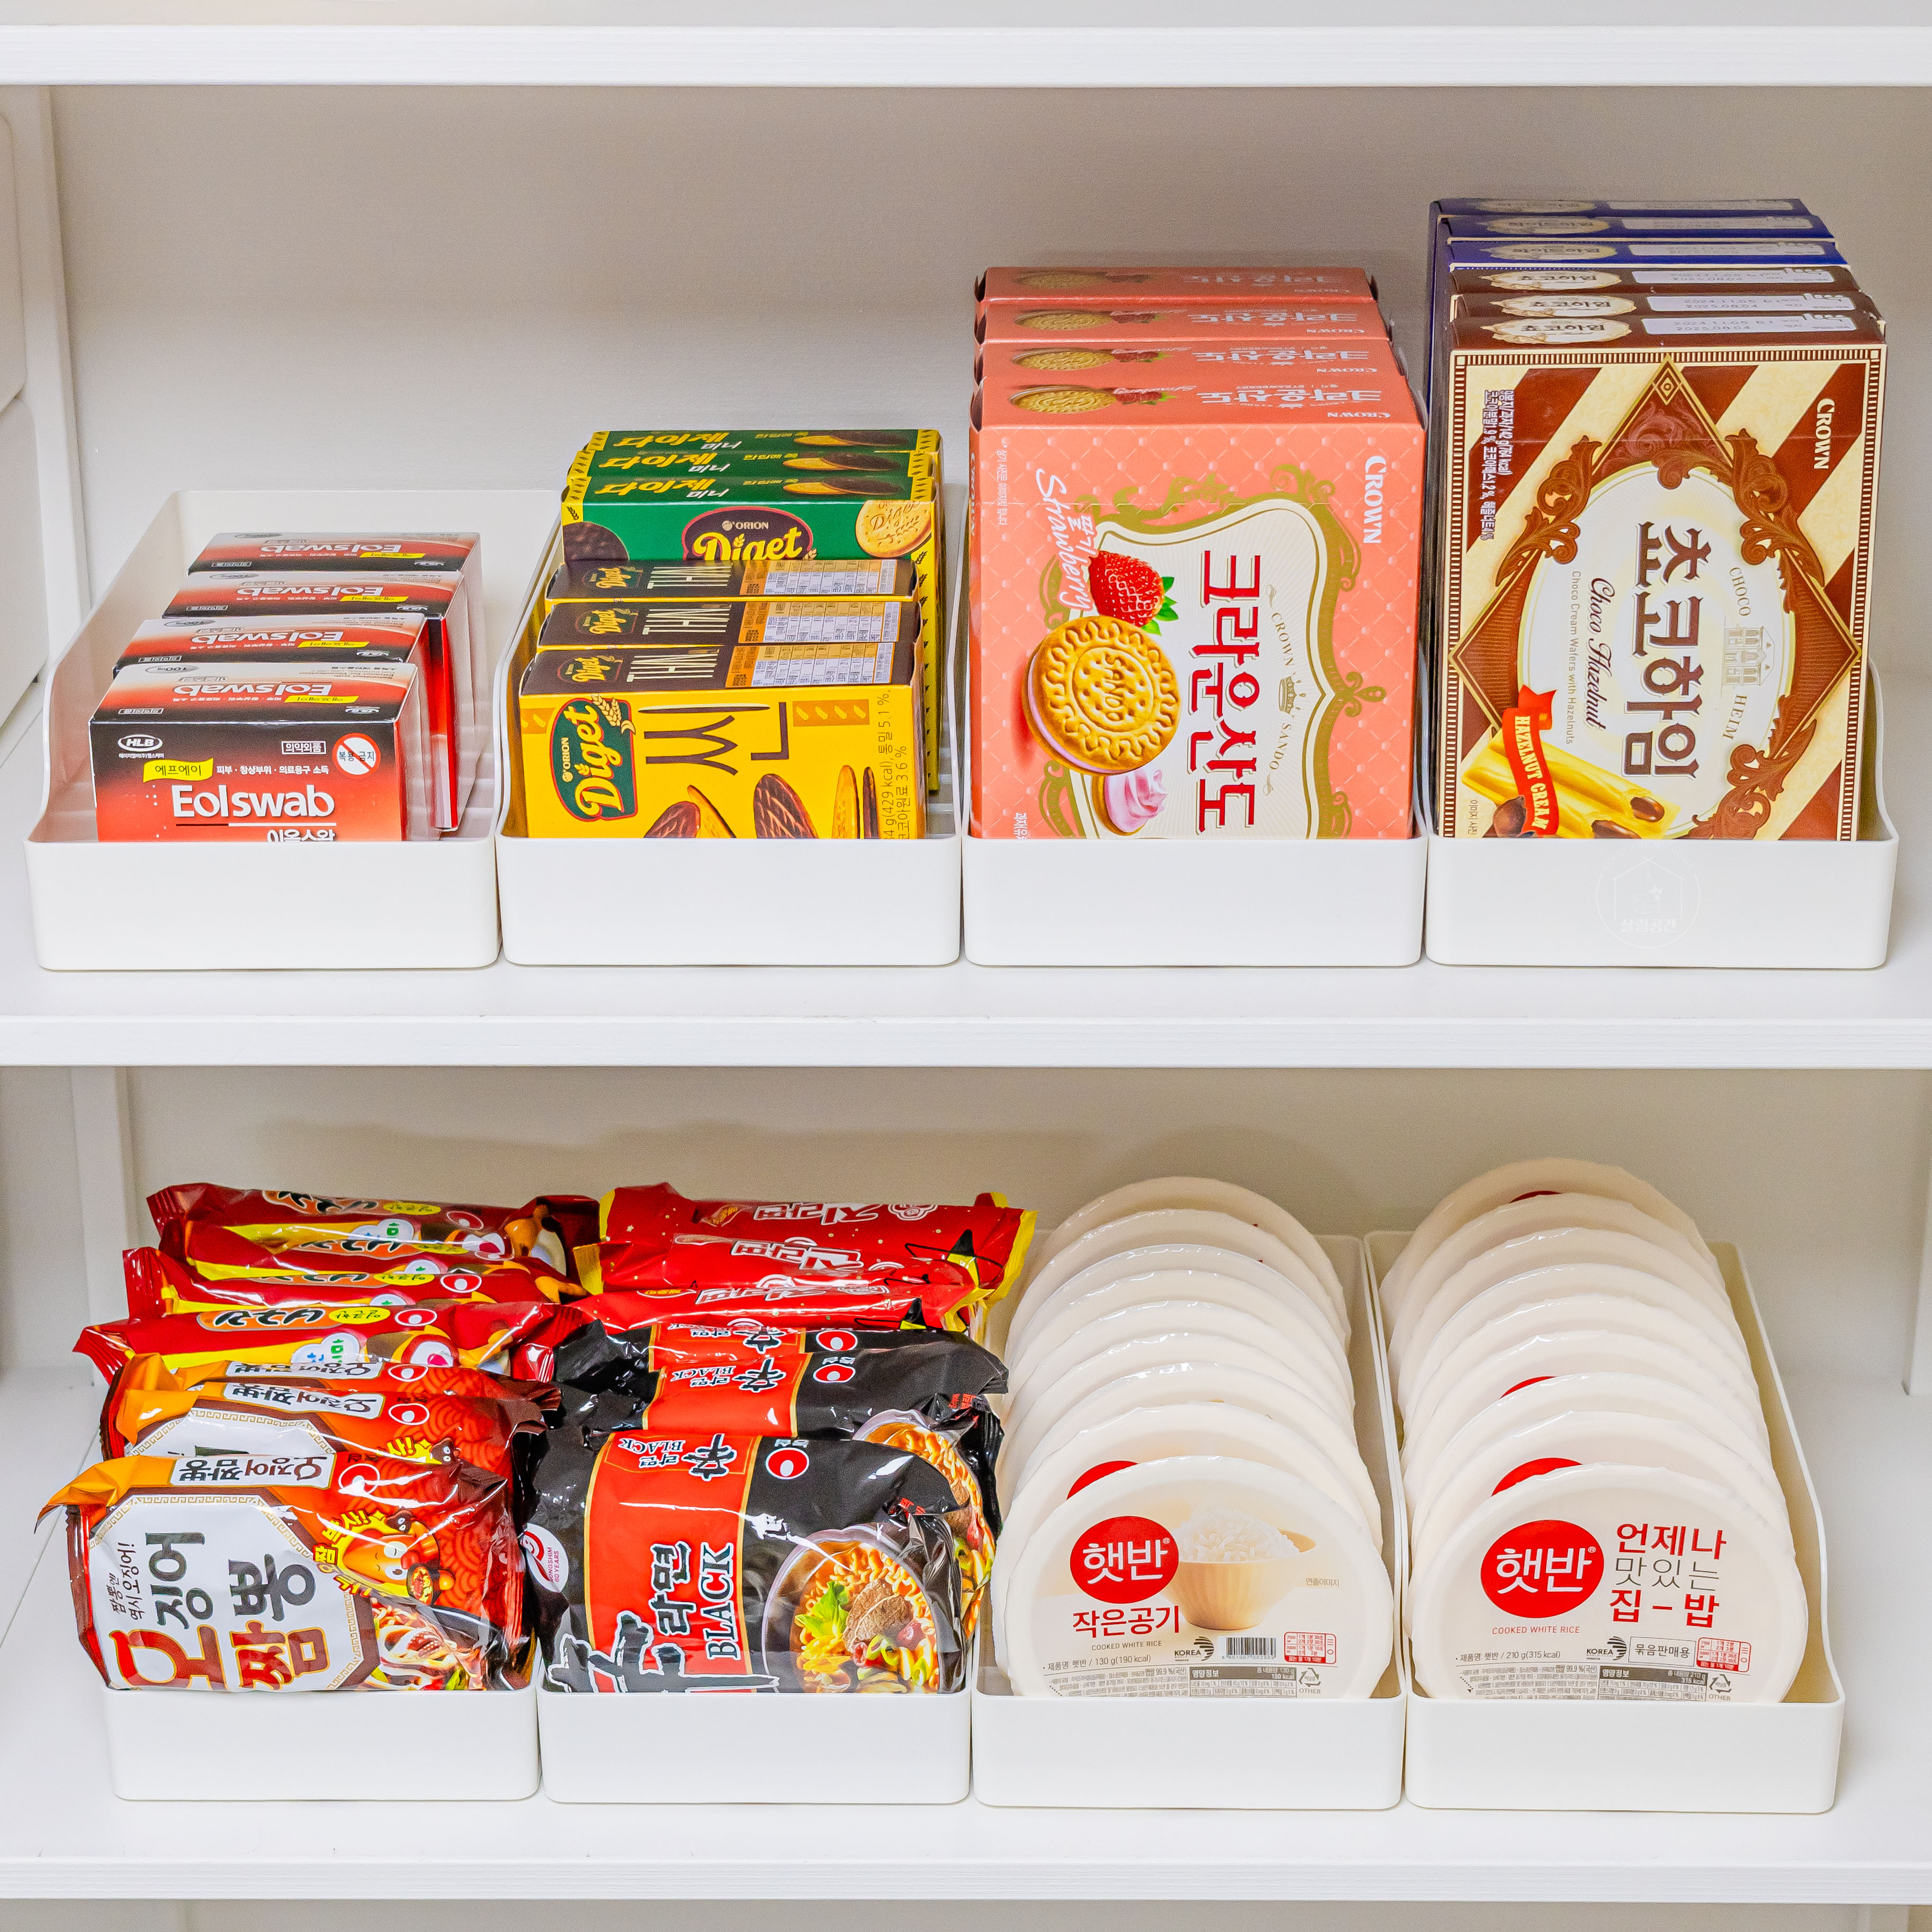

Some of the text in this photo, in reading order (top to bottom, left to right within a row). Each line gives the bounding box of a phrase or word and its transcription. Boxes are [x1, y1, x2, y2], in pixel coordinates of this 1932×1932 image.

[1190, 349, 1370, 362] 크라운산도
[1196, 389, 1381, 403] 크라운산도
[612, 432, 742, 451] 다이제 미니
[1813, 398, 1836, 470] CROWN
[598, 452, 731, 473] 다이제 미니
[996, 449, 1008, 463] 상기
[996, 463, 1008, 482] 사진은
[594, 478, 730, 499] 다이제 미니
[1363, 454, 1388, 544] CROWN
[260, 544, 401, 553] Eolswab
[1035, 466, 1095, 612] Strawberry
[1066, 514, 1099, 559] 딸기
[236, 586, 384, 597] Eolswab
[1729, 567, 1751, 617] CHOCO
[589, 609, 627, 634] Diget
[190, 631, 344, 644] Eolswab
[1566, 571, 1581, 745] Choco Cream Wafers with Hazelnuts
[1585, 577, 1615, 731] Choco Hazelnut
[1621, 522, 1712, 780] 쵸코하임
[572, 657, 610, 682] Diget
[626, 653, 718, 682] THIN
[173, 684, 333, 696] Eolswab
[1104, 653, 1125, 722] SANDO
[1187, 549, 1262, 835] 크라운산도
[1269, 612, 1295, 771] CROWN SANDO
[878, 711, 891, 728] 5.1
[1723, 694, 1748, 741] HEIM
[126, 738, 153, 747] HLB
[285, 742, 322, 753] 의약외품
[878, 731, 893, 755] 통밀
[895, 746, 907, 758] %
[1514, 716, 1543, 780] HAZELNUT
[338, 750, 375, 762] 복용 금지
[573, 704, 624, 819] Diget
[155, 764, 202, 776] 에프에이
[216, 766, 329, 775] 피부 창상부위 의료용구 소독
[895, 762, 909, 781] 3.6
[172, 785, 336, 817] Eolswab
[881, 791, 897, 826] g(429
[1468, 799, 1479, 820] 이미지
[1530, 783, 1551, 830] CREAM
[731, 1241, 864, 1270] 진라면
[213, 1308, 326, 1327] 너구리
[335, 1309, 381, 1319] 얼큰한
[670, 1365, 736, 1382] BLACK
[690, 1376, 731, 1388] 라면
[732, 1357, 786, 1394] 辛
[618, 1437, 686, 1455] BLACK
[774, 1439, 810, 1448] 농심
[638, 1452, 680, 1469] 라면
[681, 1433, 738, 1481] 辛
[179, 1457, 328, 1482] 오징어짬뽕
[1616, 1522, 1727, 1560] 언제나
[1082, 1539, 1169, 1584] 햇반
[1496, 1547, 1593, 1595] 햇반
[117, 1542, 146, 1620] 역시 오징어!
[1614, 1557, 1720, 1592] 맛있는
[106, 1572, 127, 1615] 짬뽕엔
[652, 1542, 694, 1637] 라면
[698, 1542, 740, 1660] BLACK
[108, 1531, 227, 1690] 오징어
[228, 1553, 331, 1690] 짬뽕
[1073, 1605, 1180, 1639] 작은공기
[1492, 1626, 1527, 1634] COOKED
[1530, 1625, 1557, 1634] WHITE
[1091, 1640, 1162, 1651] COOKED WHITE RICE
[1460, 1652, 1483, 1662] 제품명:
[1484, 1651, 1498, 1661] 햇반
[1521, 1650, 1542, 1660] g(315
[1634, 1643, 1691, 1659] 묶음판매용
[1047, 1661, 1071, 1670] 제품명:
[1072, 1659, 1086, 1668] 햇반
[1094, 1657, 1109, 1666] 130
[1110, 1655, 1133, 1666] g(190
[1134, 1654, 1152, 1663] kcal)
[1192, 1669, 1219, 1678] 영양정보
[1601, 1669, 1629, 1678] 영양정보
